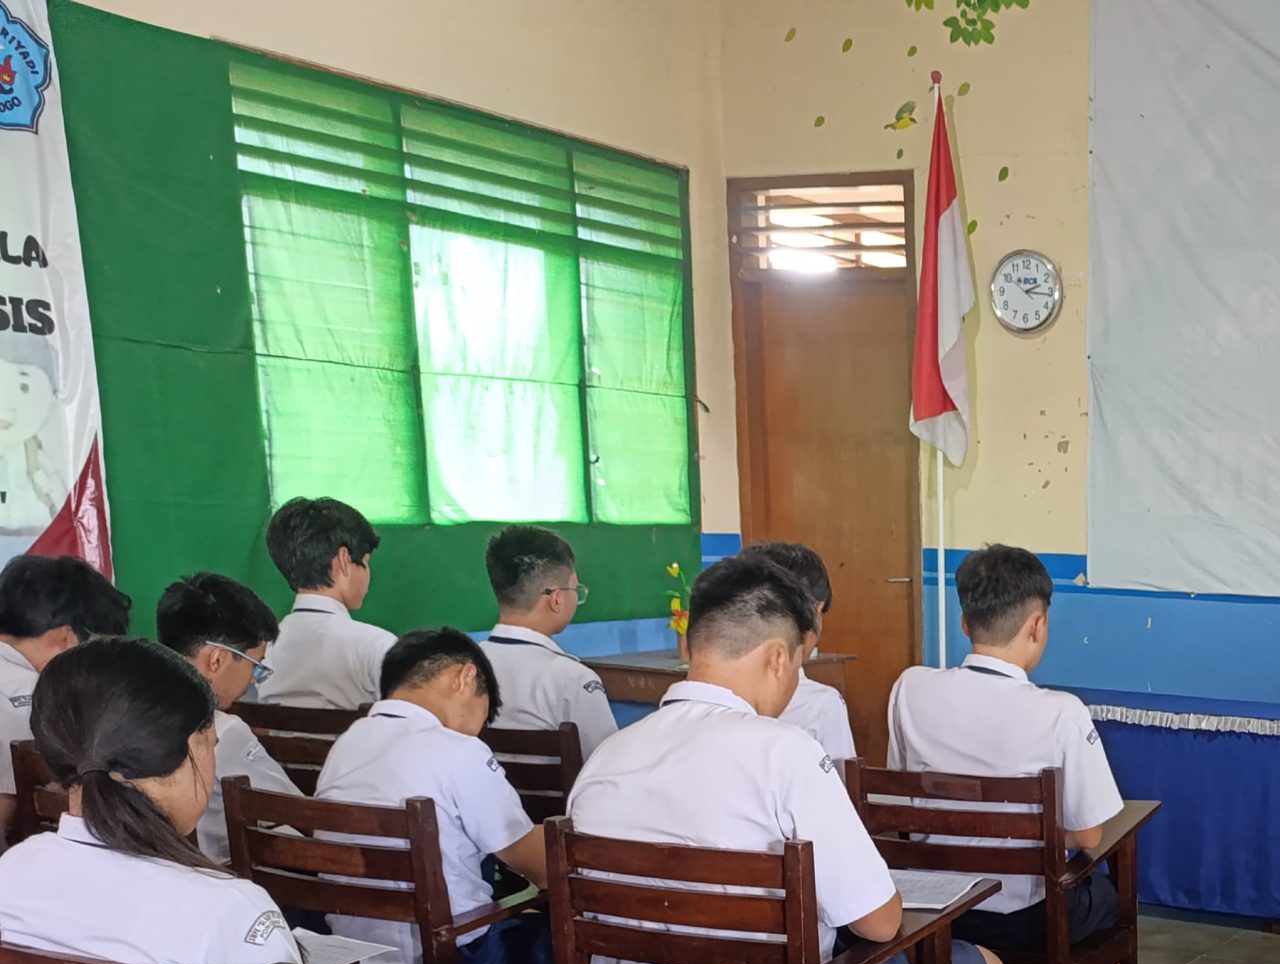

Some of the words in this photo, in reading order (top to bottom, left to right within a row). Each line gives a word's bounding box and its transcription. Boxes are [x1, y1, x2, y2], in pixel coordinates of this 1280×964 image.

[0, 26, 39, 75] RIYADI
[1012, 263, 1019, 273] 11
[1022, 260, 1031, 270] 12
[1004, 273, 1012, 283] 10
[1044, 273, 1050, 283] 2
[999, 286, 1005, 296] 9
[1003, 300, 1009, 311] 8
[1043, 301, 1049, 311] 4
[1013, 310, 1018, 320] 7
[1023, 313, 1029, 323] 6
[1035, 310, 1040, 320] 5
